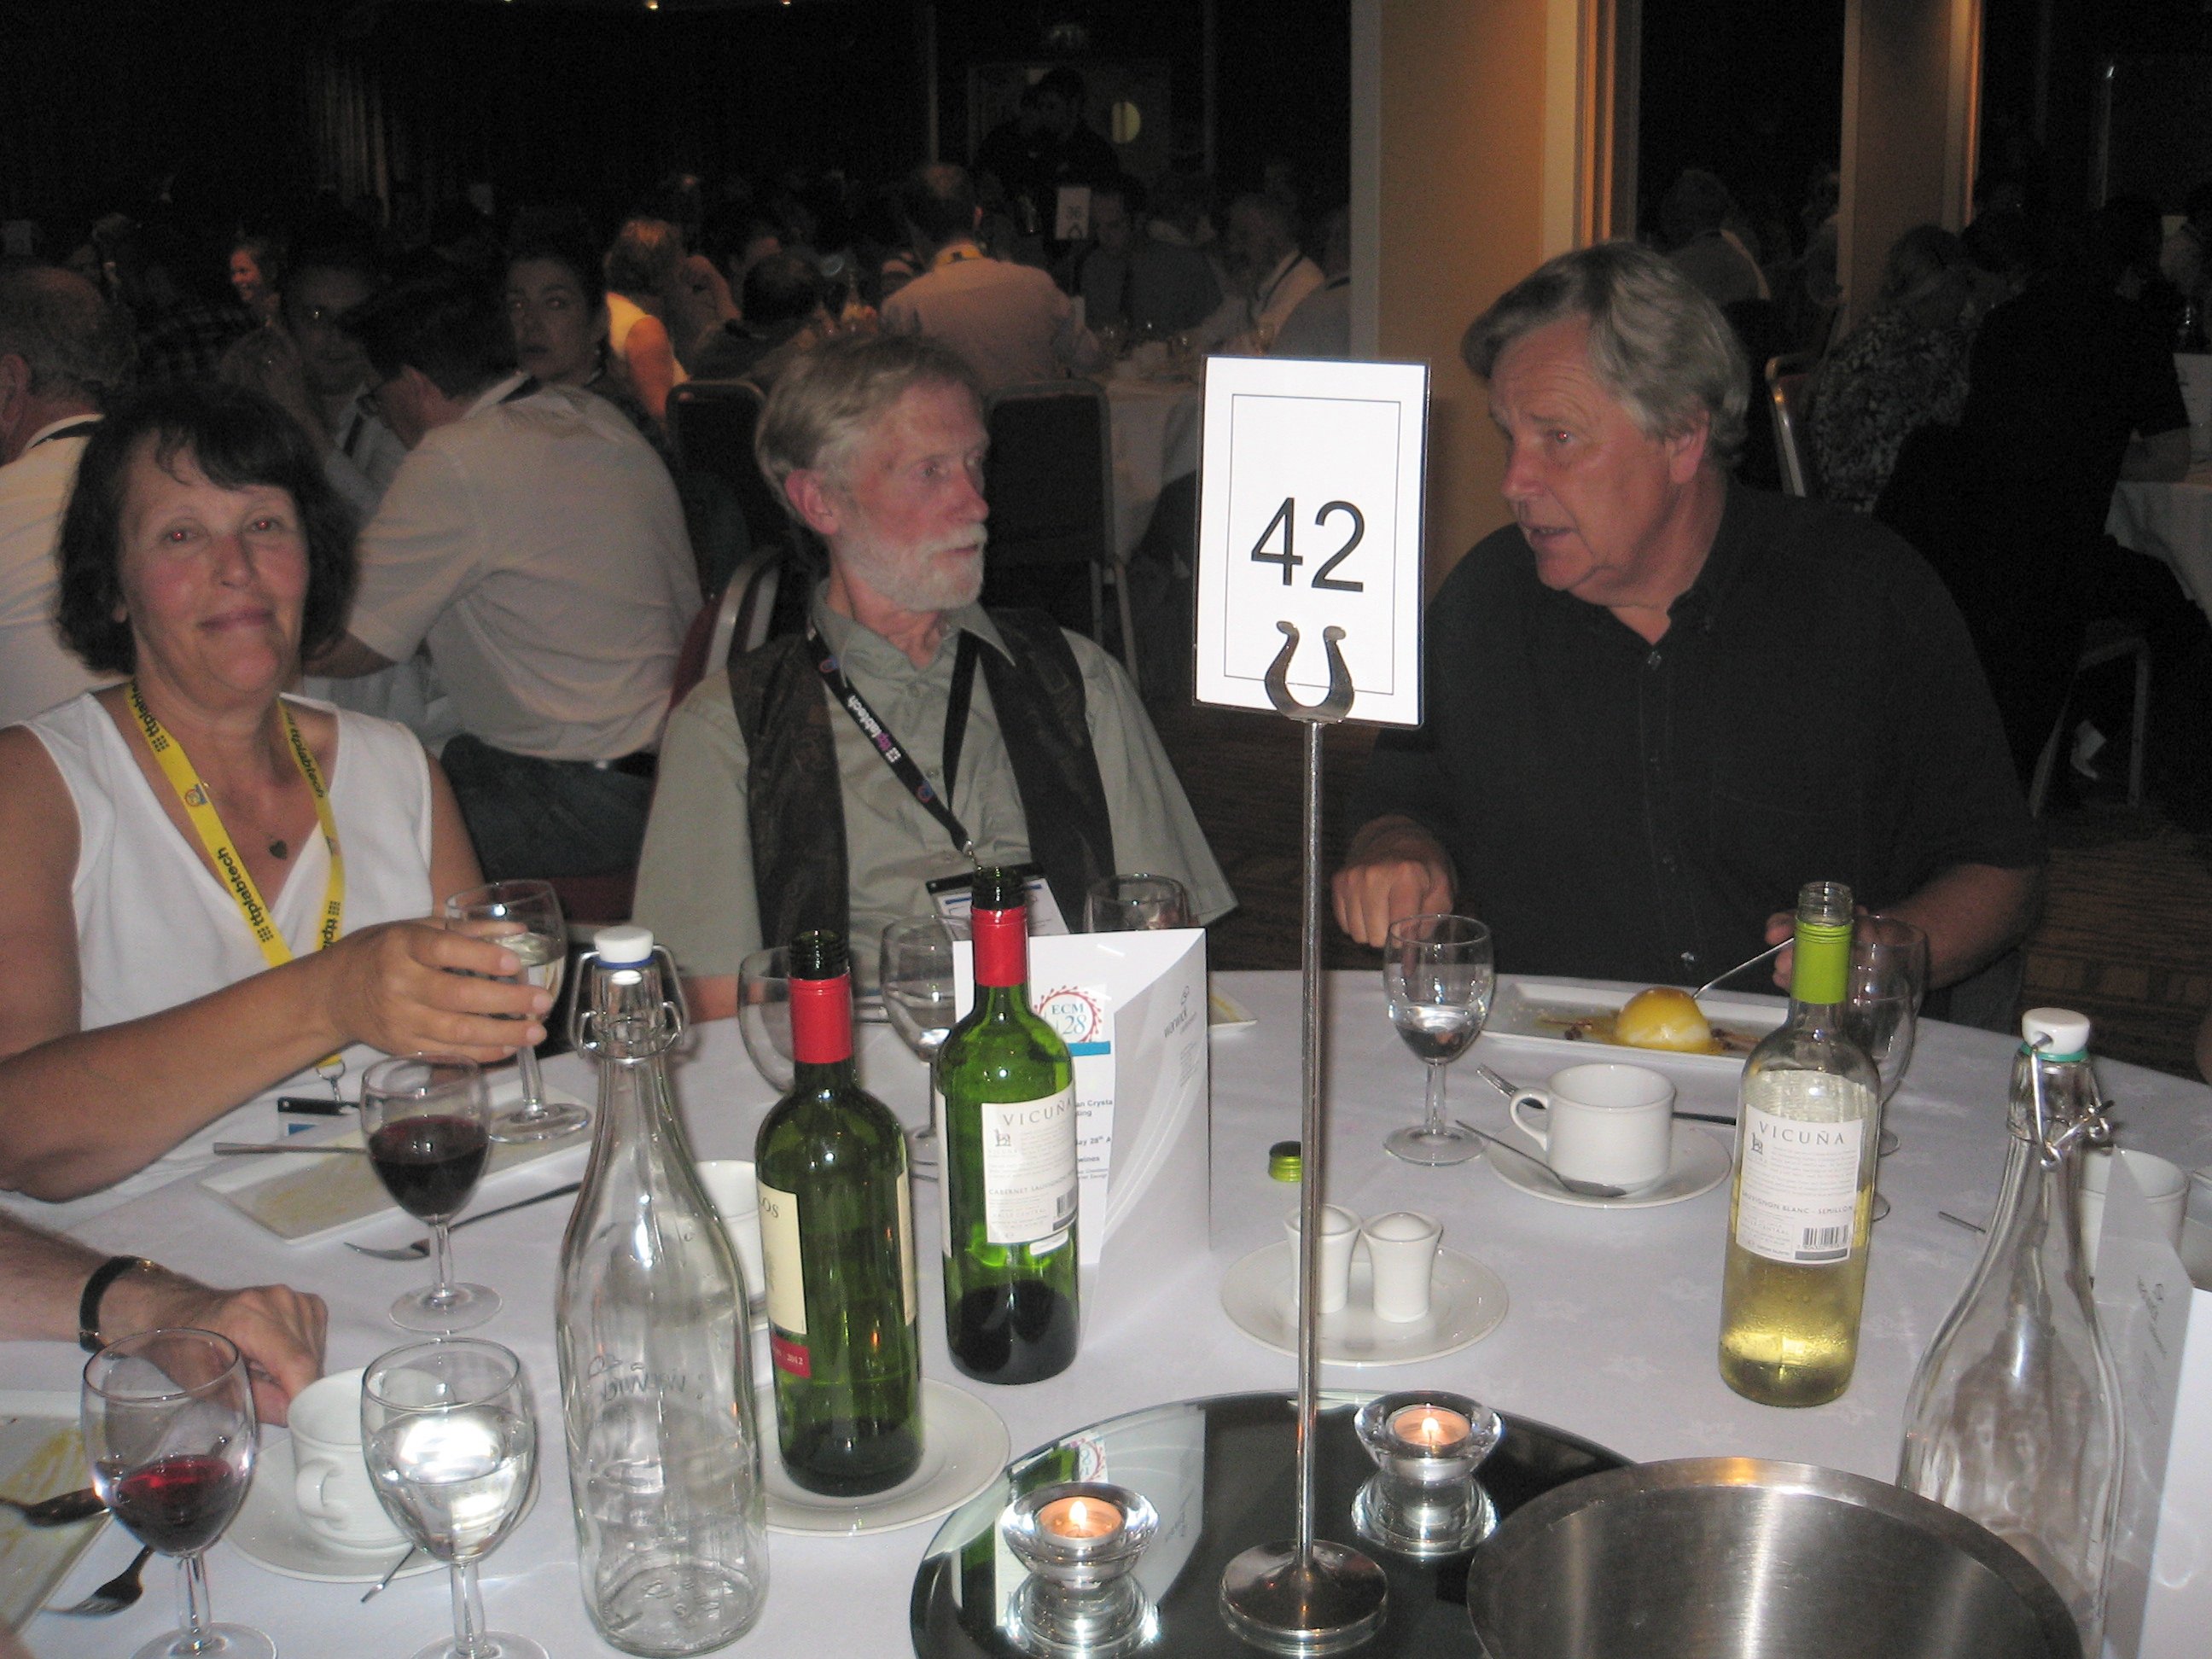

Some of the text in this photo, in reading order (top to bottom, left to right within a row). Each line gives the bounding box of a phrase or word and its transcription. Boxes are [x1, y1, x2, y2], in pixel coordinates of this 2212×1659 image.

[1251, 498, 1365, 592] 42
[218, 847, 265, 927] ttplabtech
[1051, 1003, 1084, 1015] ECM
[1063, 1014, 1087, 1034] 28
[1759, 1121, 1844, 1145] VICUÑA
[1782, 1204, 1809, 1214] BLANC
